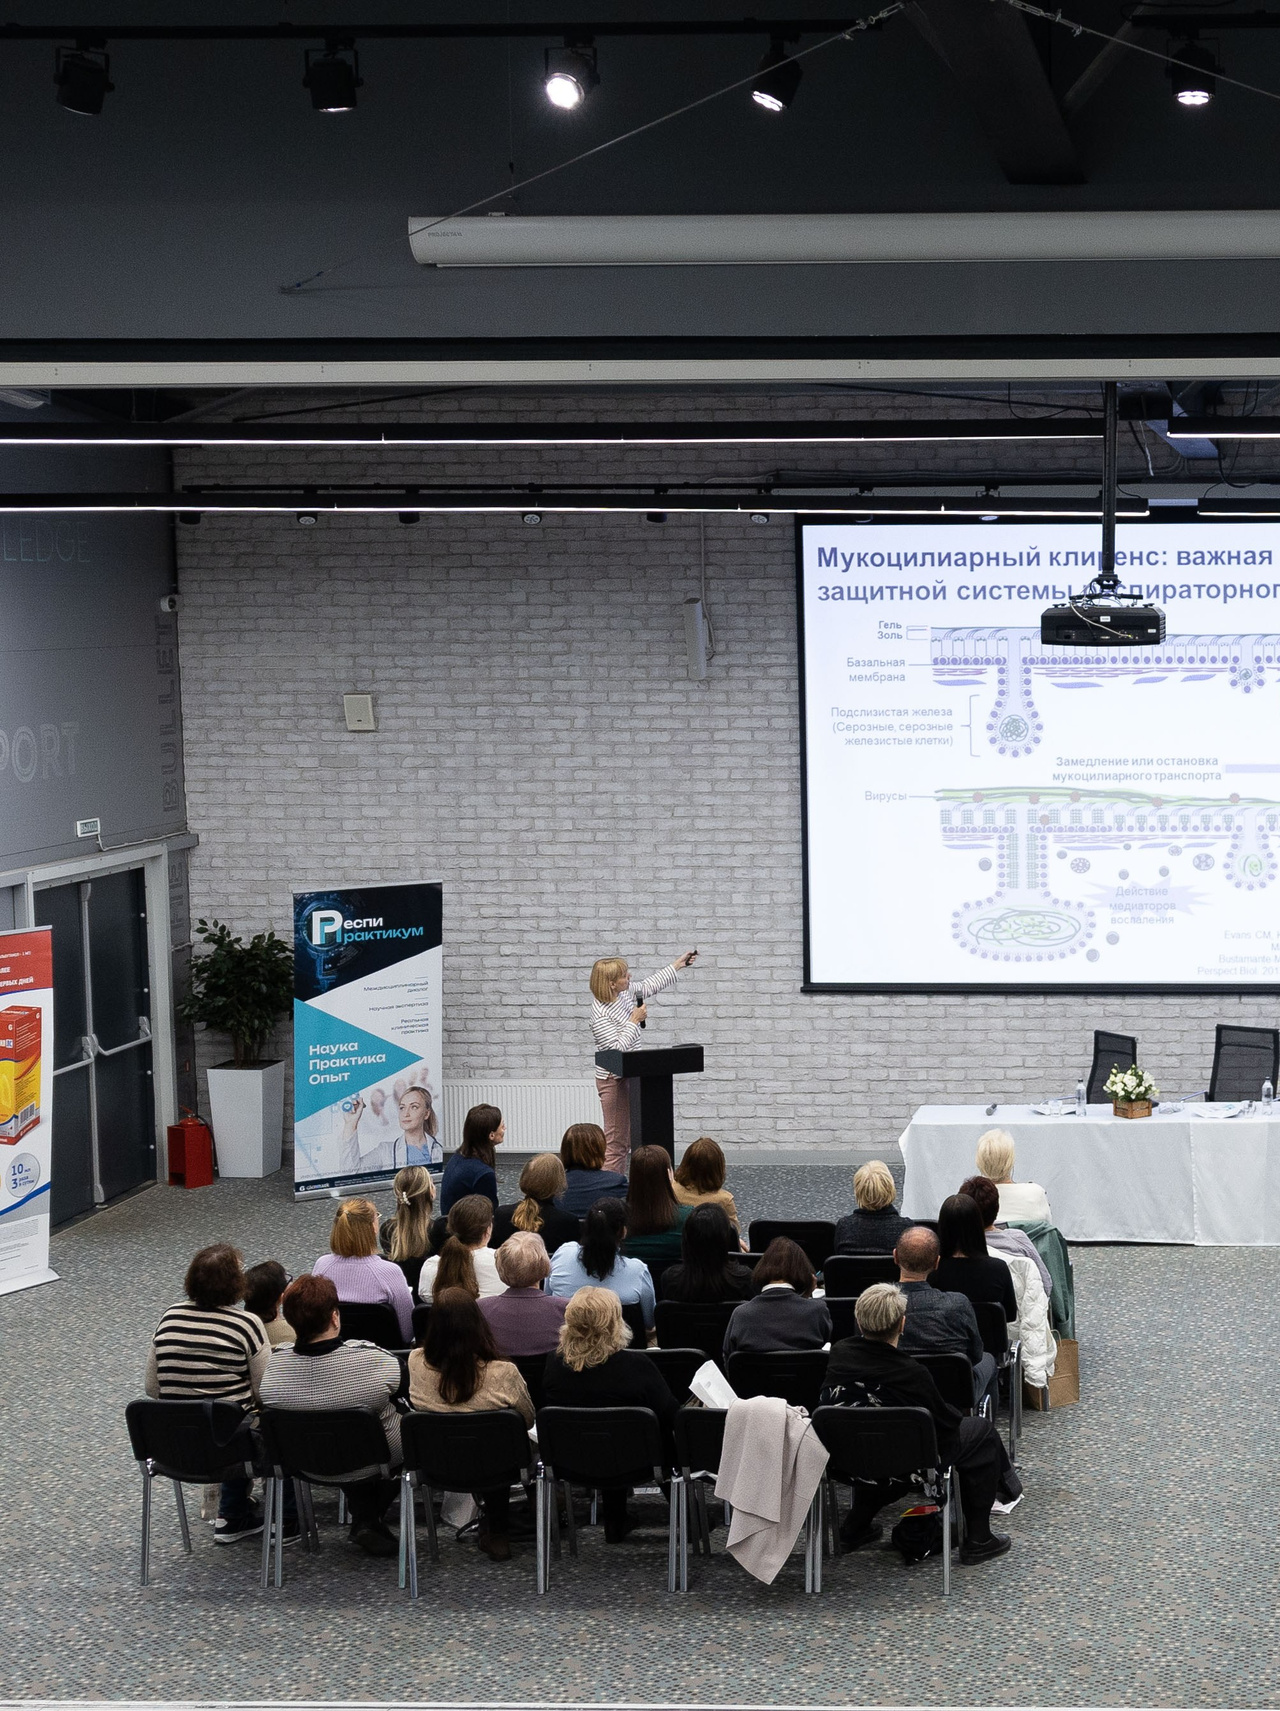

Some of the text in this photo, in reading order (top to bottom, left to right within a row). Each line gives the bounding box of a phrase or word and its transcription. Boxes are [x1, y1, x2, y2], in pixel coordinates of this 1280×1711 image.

[817, 545, 1041, 573] Мукоцилиарный
[1049, 550, 1167, 571] клиенс:
[1176, 550, 1273, 566] важная
[817, 579, 947, 604] защитной
[956, 583, 1073, 601] системы
[878, 620, 903, 630] Гель
[877, 631, 903, 640] Золь
[846, 657, 906, 668] Базальная
[849, 672, 906, 683] мембрана
[831, 707, 953, 718] Подслизистая железа
[899, 723, 954, 732] серозные
[844, 735, 954, 747] железистые клетки)
[1056, 756, 1219, 768] Замедление или остановка
[1052, 771, 1222, 783] мукоцилиарного транспорта
[864, 791, 908, 803] Вирусы
[1115, 886, 1169, 897] Действие
[1109, 902, 1177, 913] медиаторов
[1110, 915, 1175, 926] воспаления
[308, 1041, 358, 1057] Наука
[308, 1052, 387, 1072] Практика
[308, 1072, 351, 1086] Опыт
[11, 1163, 24, 1176] 10
[11, 1178, 18, 1190] 3
